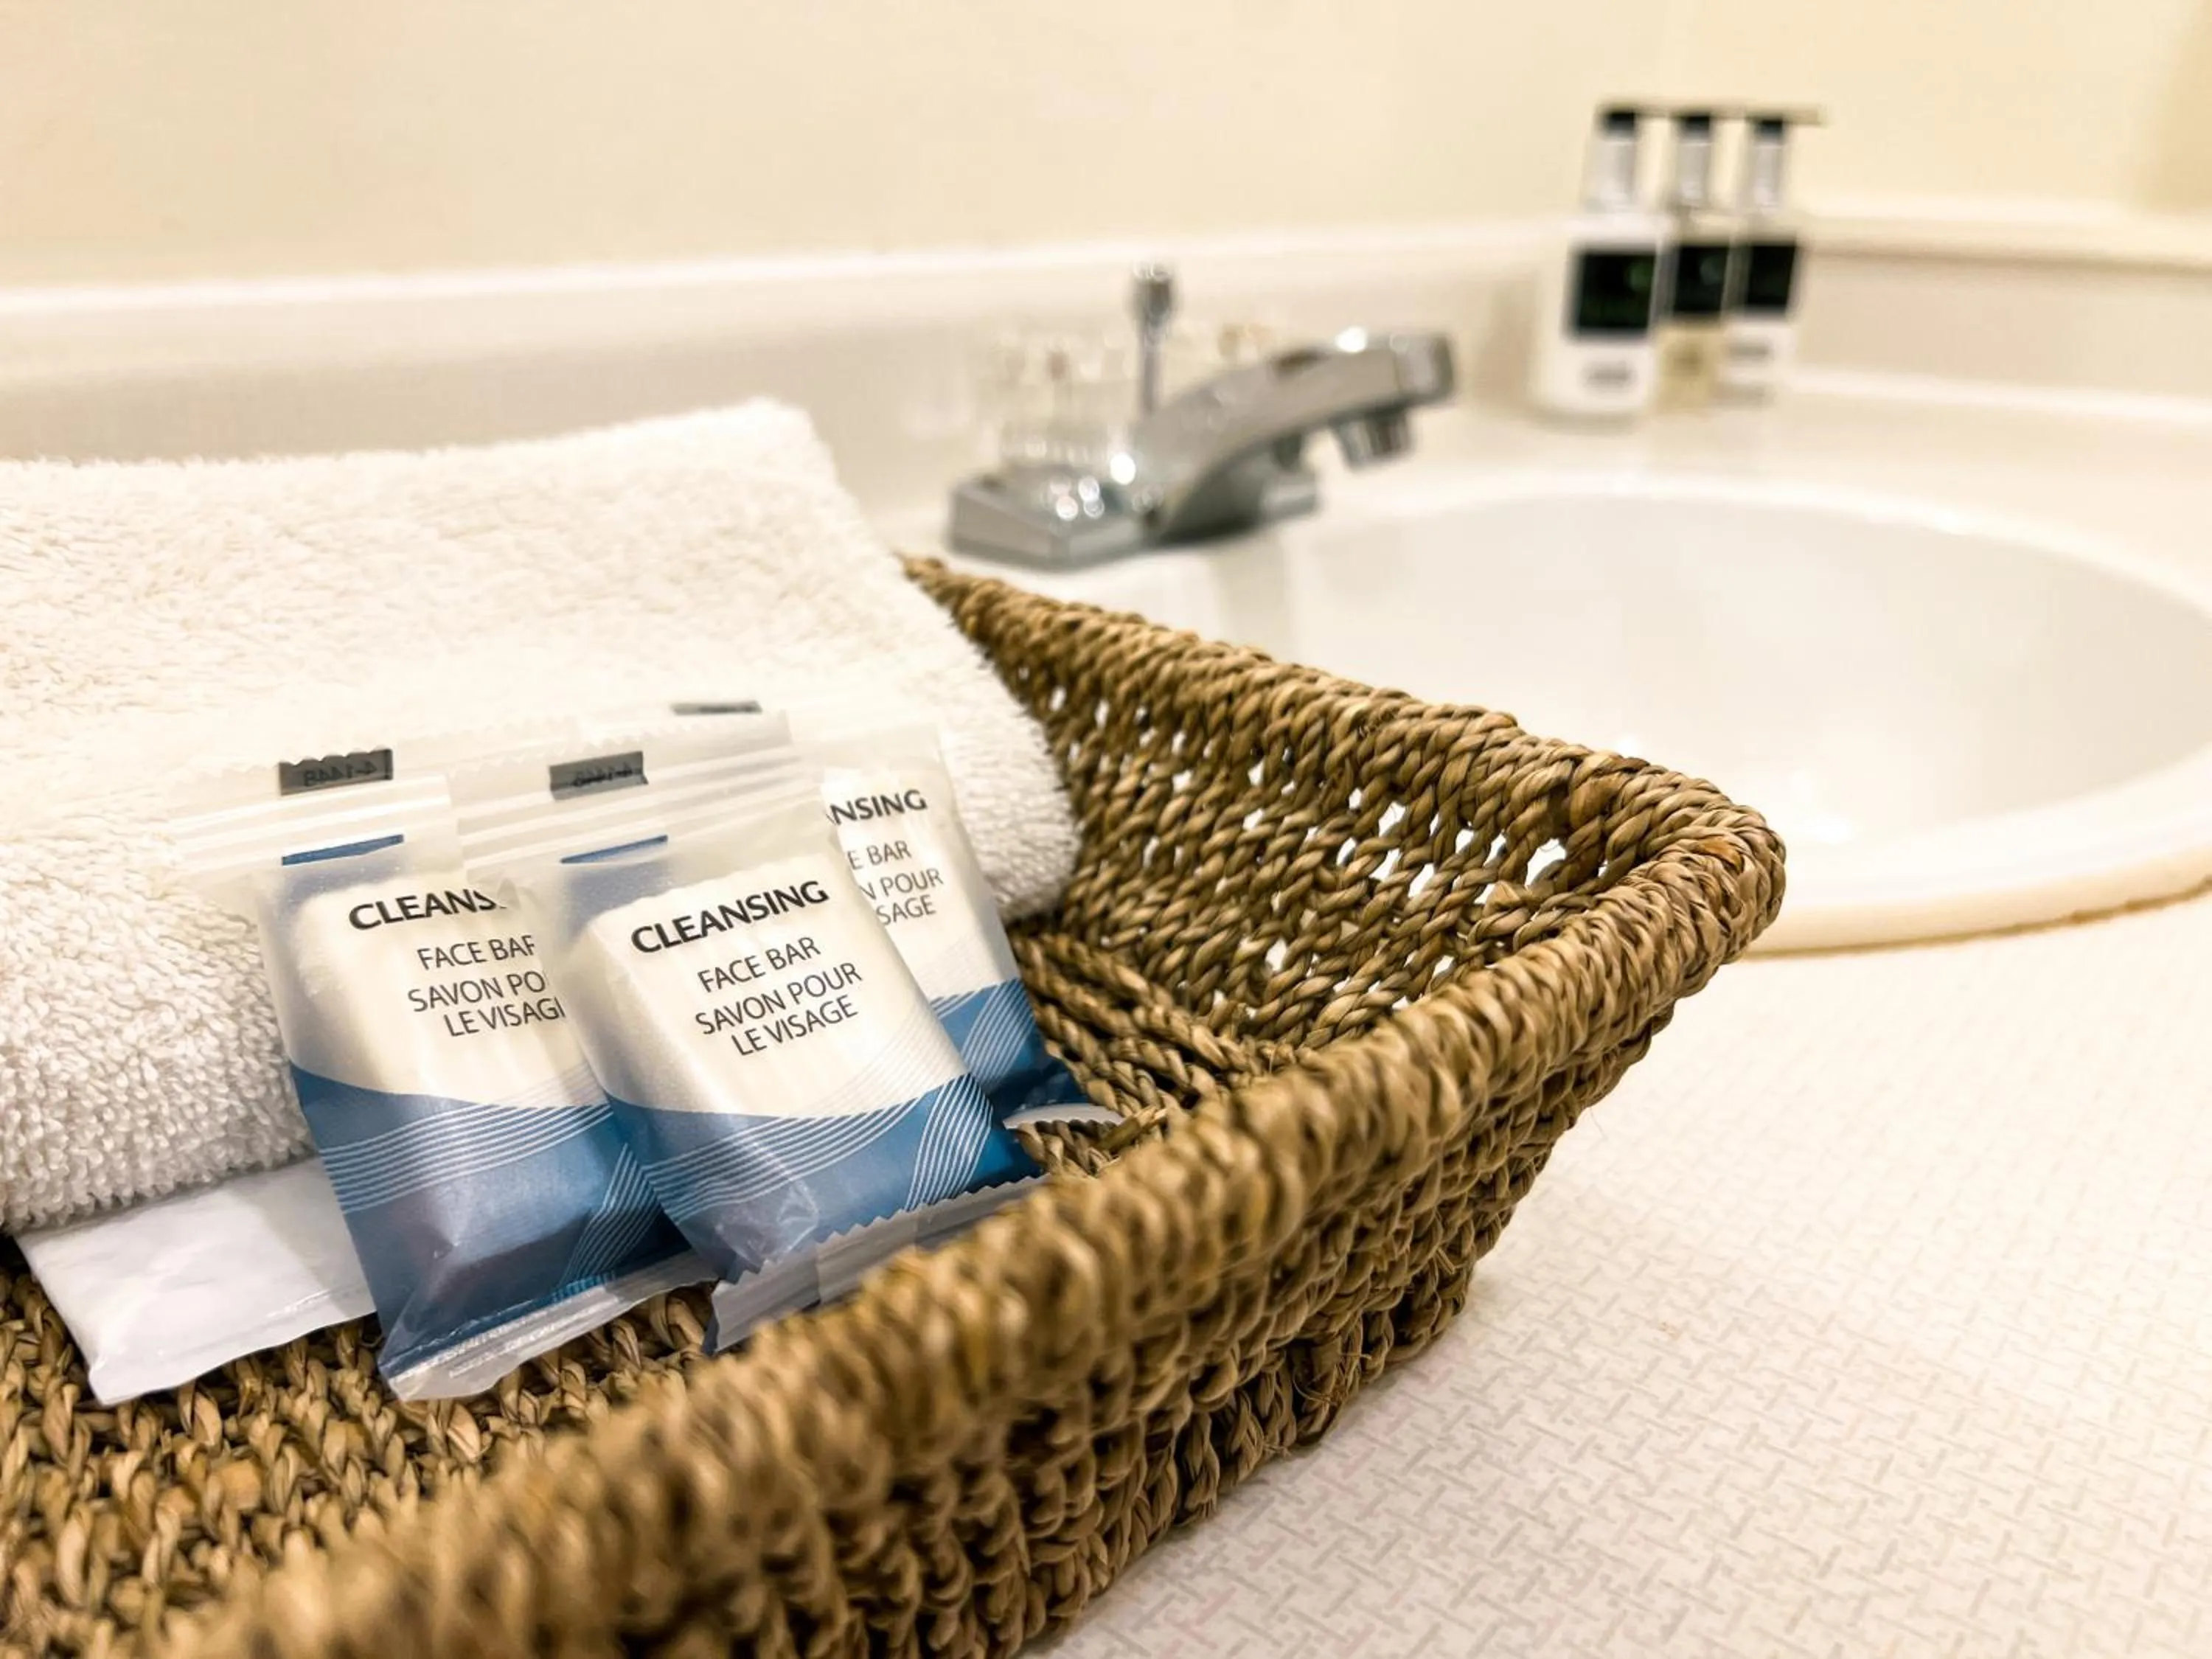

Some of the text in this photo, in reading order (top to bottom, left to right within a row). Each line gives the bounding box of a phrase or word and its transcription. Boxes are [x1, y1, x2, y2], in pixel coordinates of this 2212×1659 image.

[825, 789, 928, 826] NSING
[866, 840, 912, 866] BAR
[880, 868, 945, 897] POUR
[348, 888, 508, 931] CLEANS
[630, 880, 830, 954] CLEANSING
[416, 941, 488, 971] FACE
[698, 936, 821, 993] FACE BAR
[408, 970, 549, 1012] SAVON PO
[695, 961, 863, 1034] SAVON POUR
[443, 996, 566, 1037] LE VISAG
[731, 995, 858, 1057] LE VISAGE
